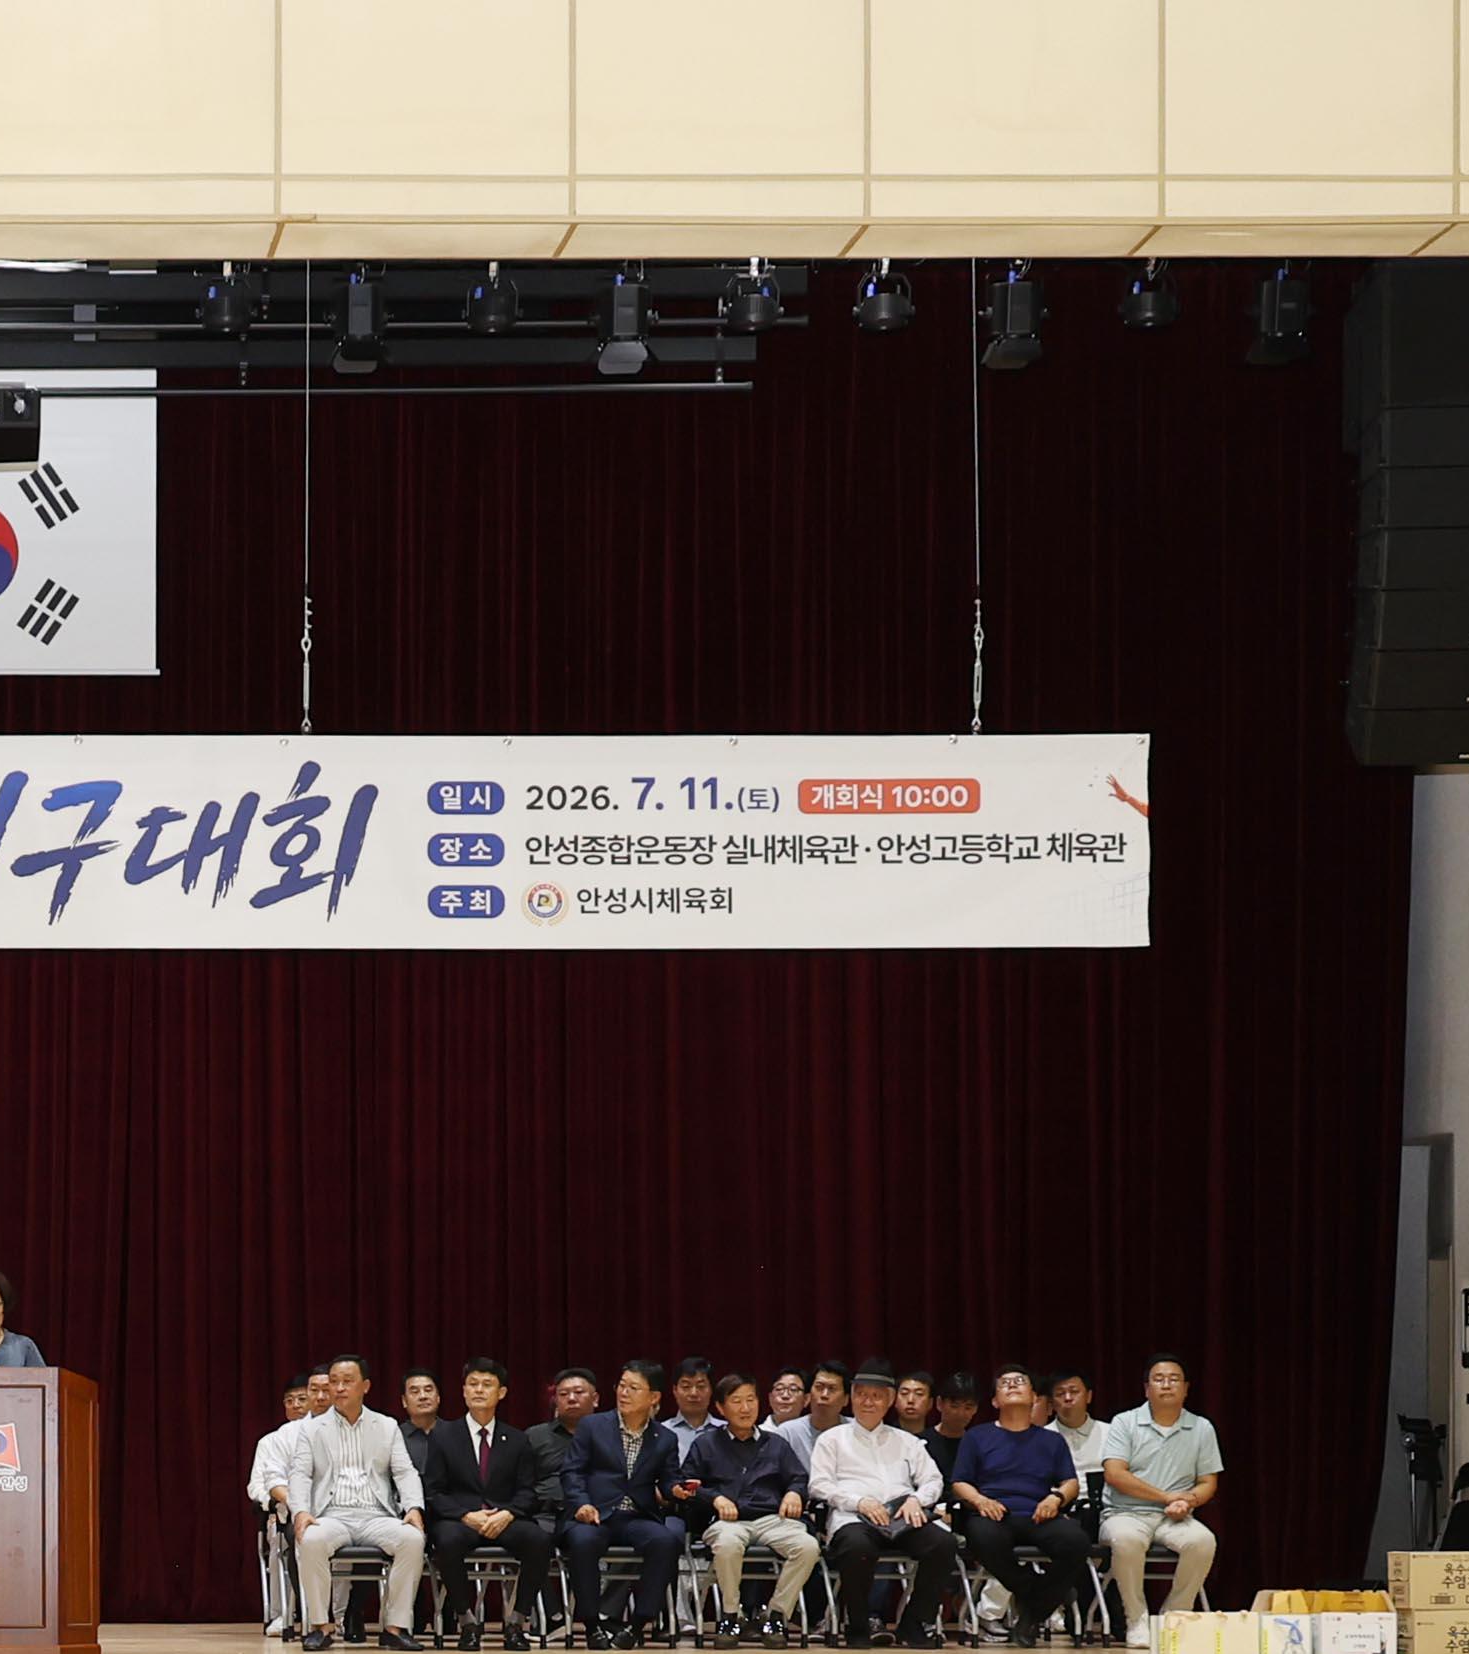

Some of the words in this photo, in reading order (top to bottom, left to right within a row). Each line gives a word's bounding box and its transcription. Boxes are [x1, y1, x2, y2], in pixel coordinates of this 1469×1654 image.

[526, 785, 620, 812] 2026.
[630, 777, 665, 811] 7.
[810, 784, 885, 810] 개회식
[892, 785, 969, 808] 10:00
[525, 834, 716, 865] 안성종합운동장
[722, 834, 858, 864] 실내체육관
[876, 833, 1041, 864] 안성고등학교
[1046, 832, 1127, 864] 체육관
[576, 886, 734, 916] 안성시체육회
[1, 1476, 27, 1491] 안성
